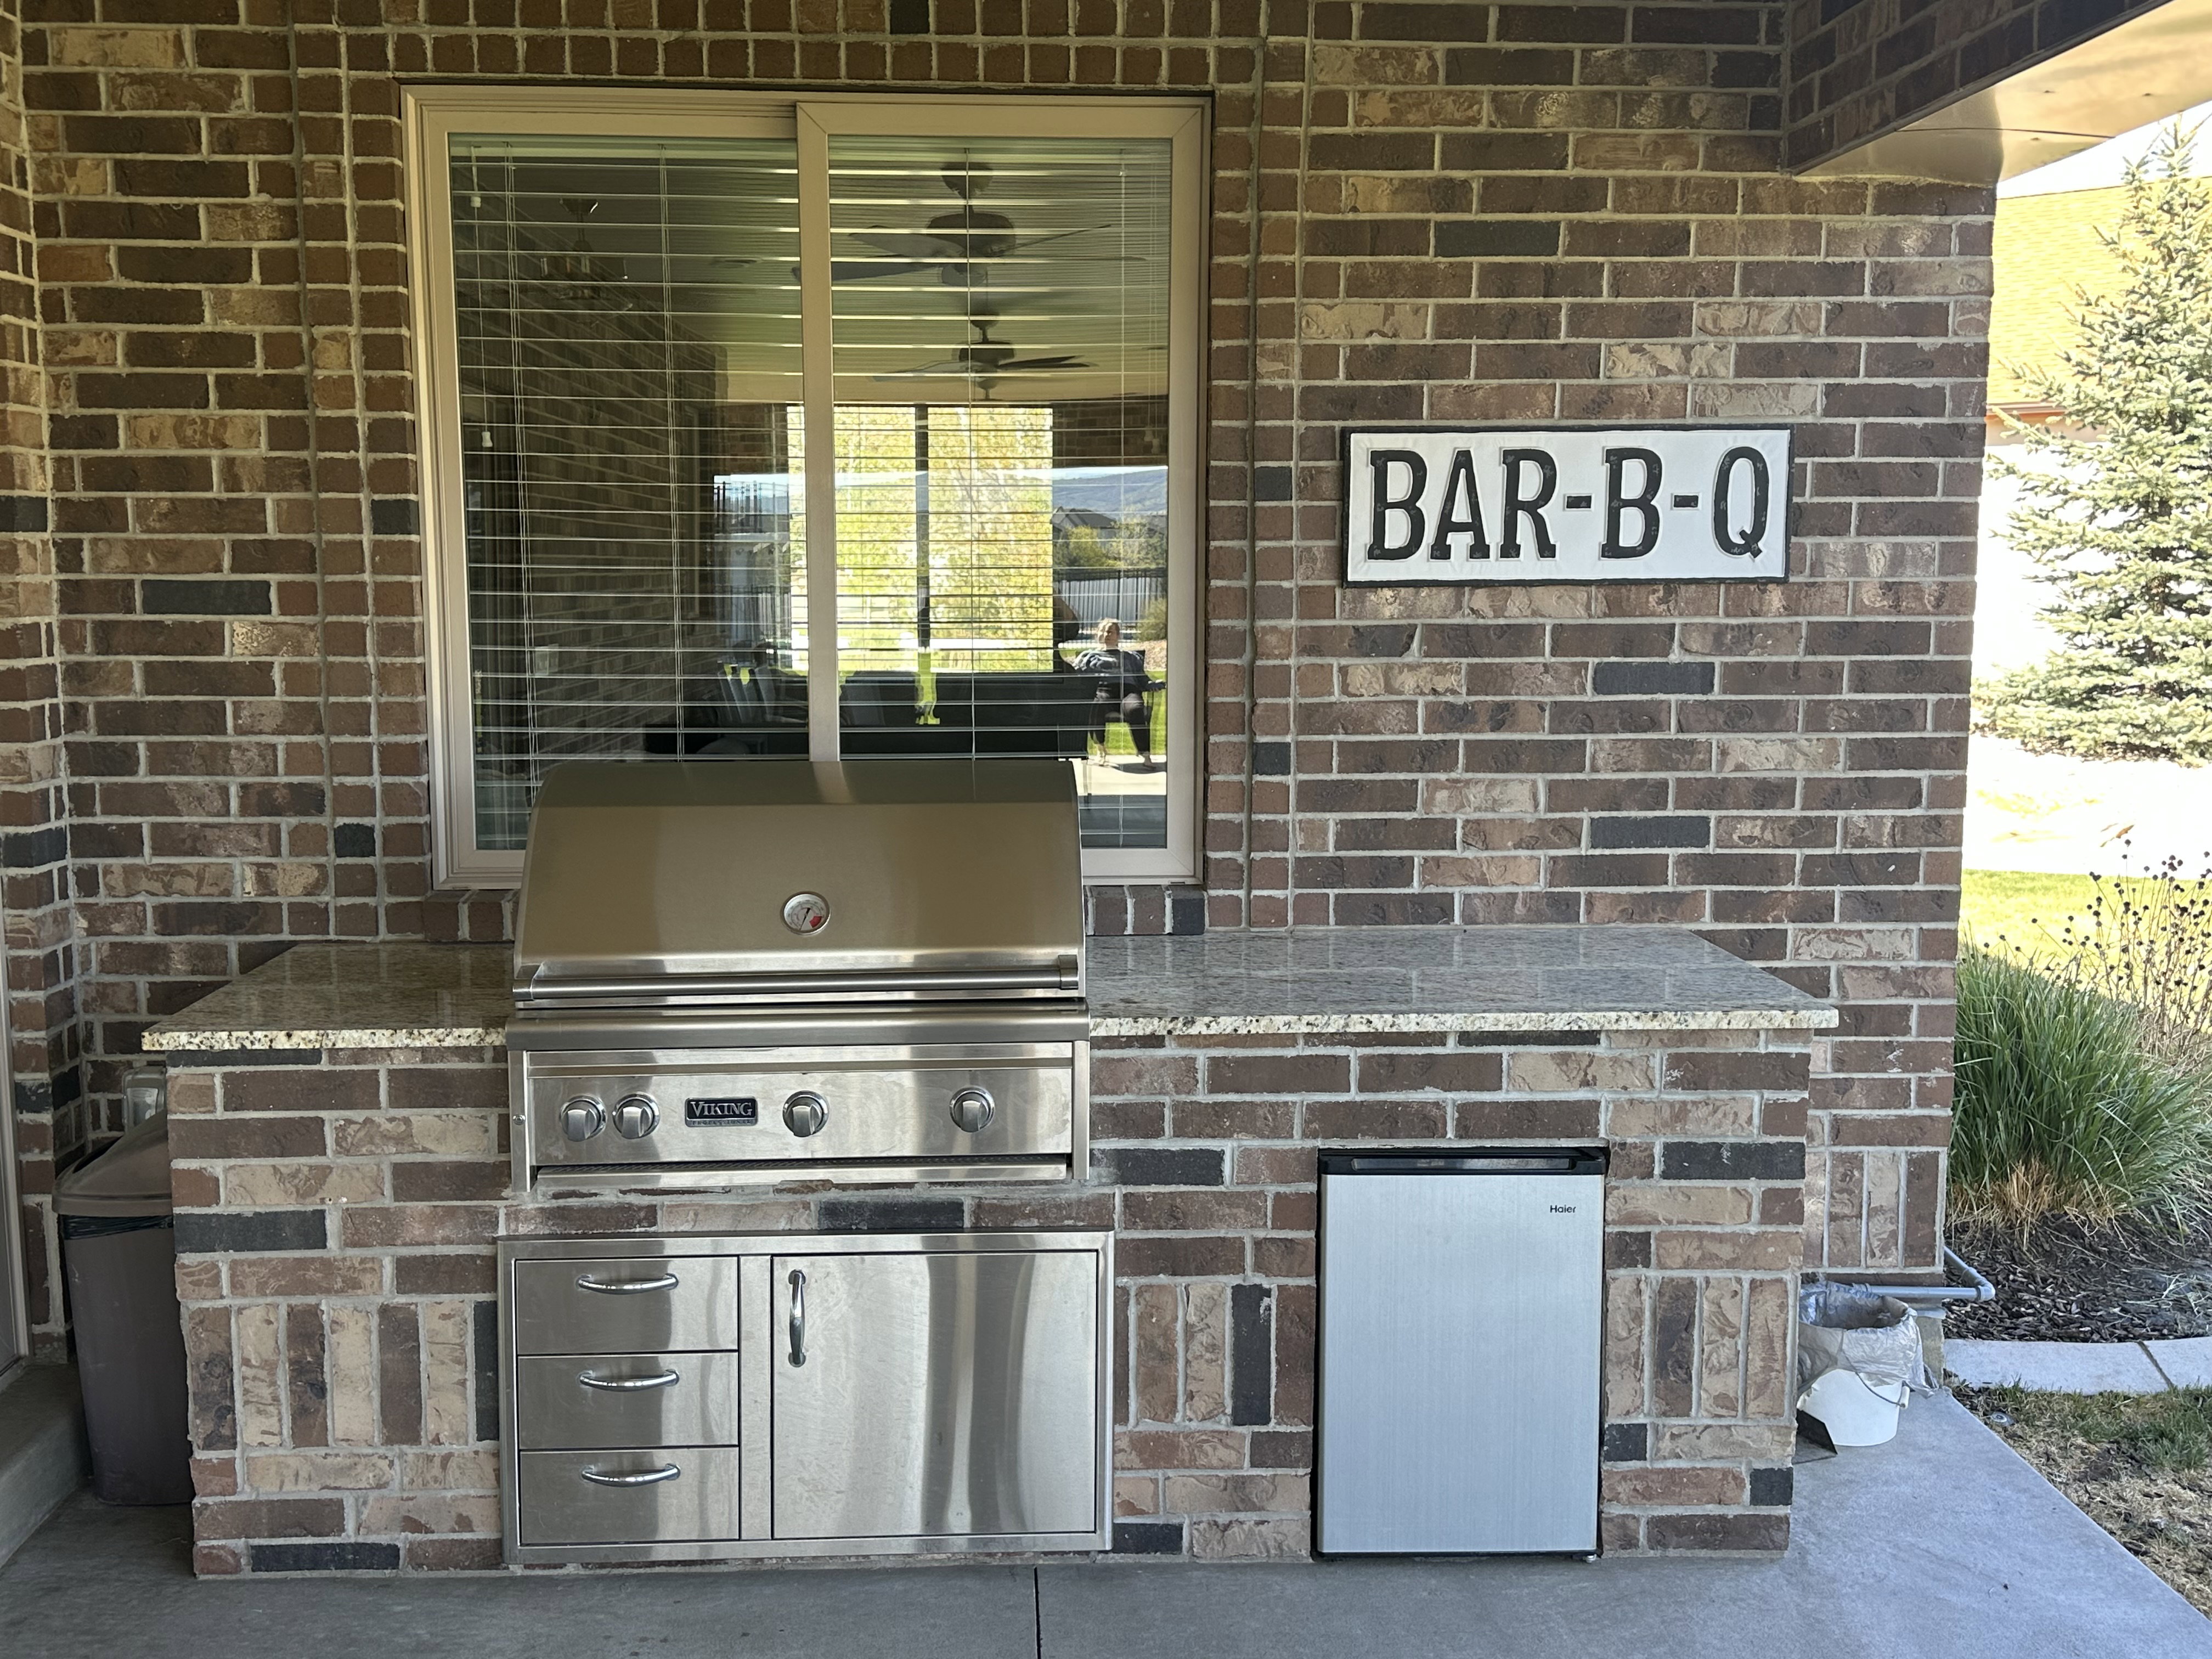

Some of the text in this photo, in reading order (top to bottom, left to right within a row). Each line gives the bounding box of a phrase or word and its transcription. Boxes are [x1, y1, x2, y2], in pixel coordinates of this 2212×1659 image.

[1367, 446, 1769, 561] BAR-B-Q
[690, 1102, 753, 1117] VIKING
[1550, 1204, 1576, 1213] Haier
